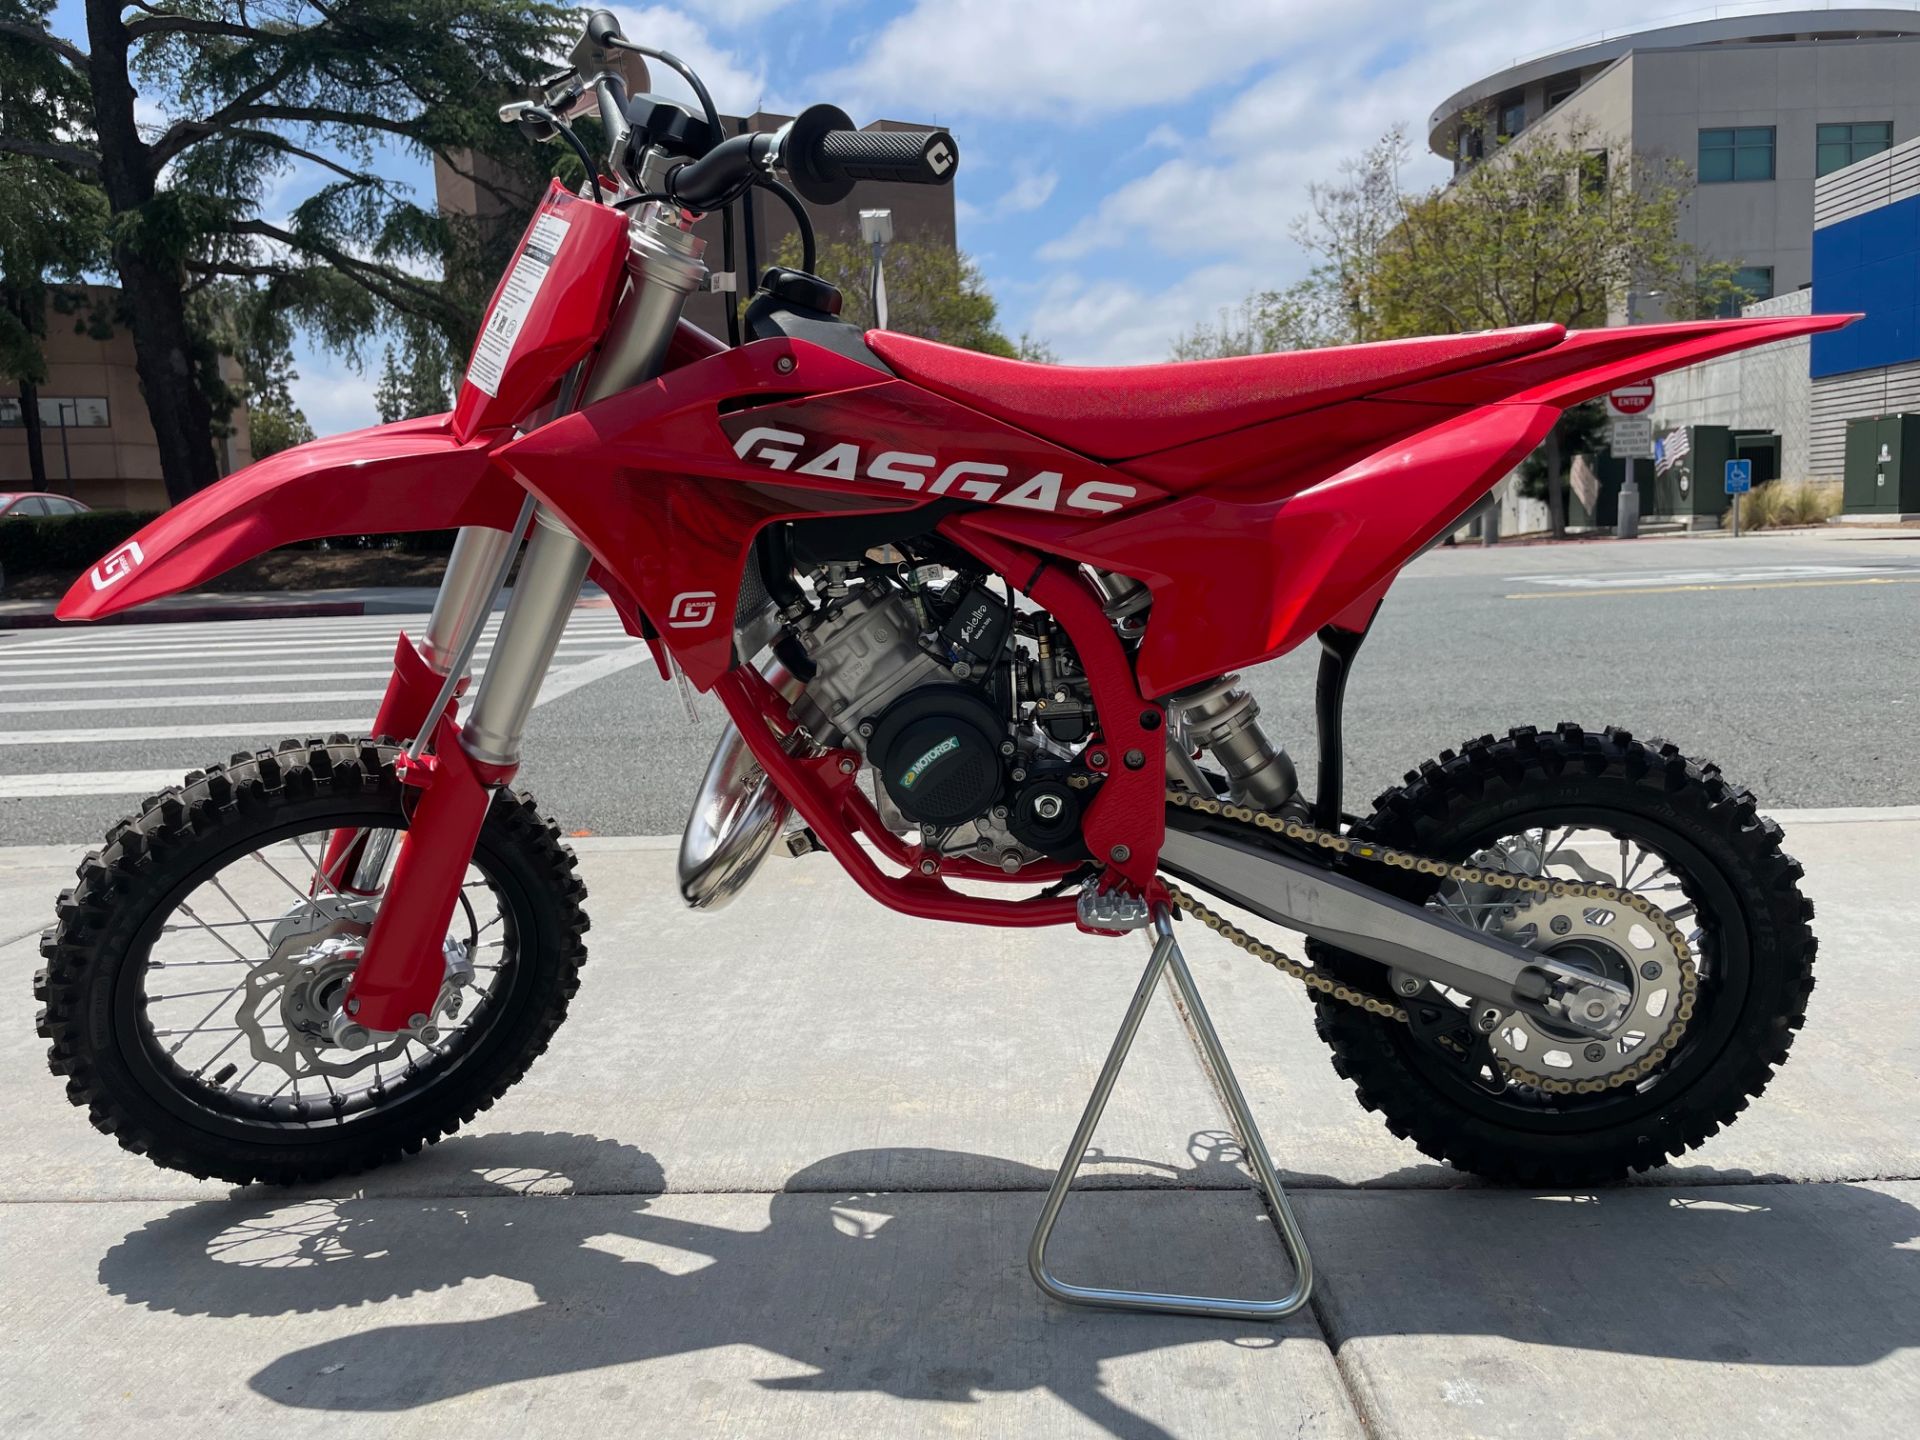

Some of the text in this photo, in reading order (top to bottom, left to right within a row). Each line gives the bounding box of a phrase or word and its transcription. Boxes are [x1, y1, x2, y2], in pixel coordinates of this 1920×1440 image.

[1618, 397, 1645, 407] ENTER
[732, 427, 1138, 513] GASGAS
[912, 738, 958, 775] MOTOREX
